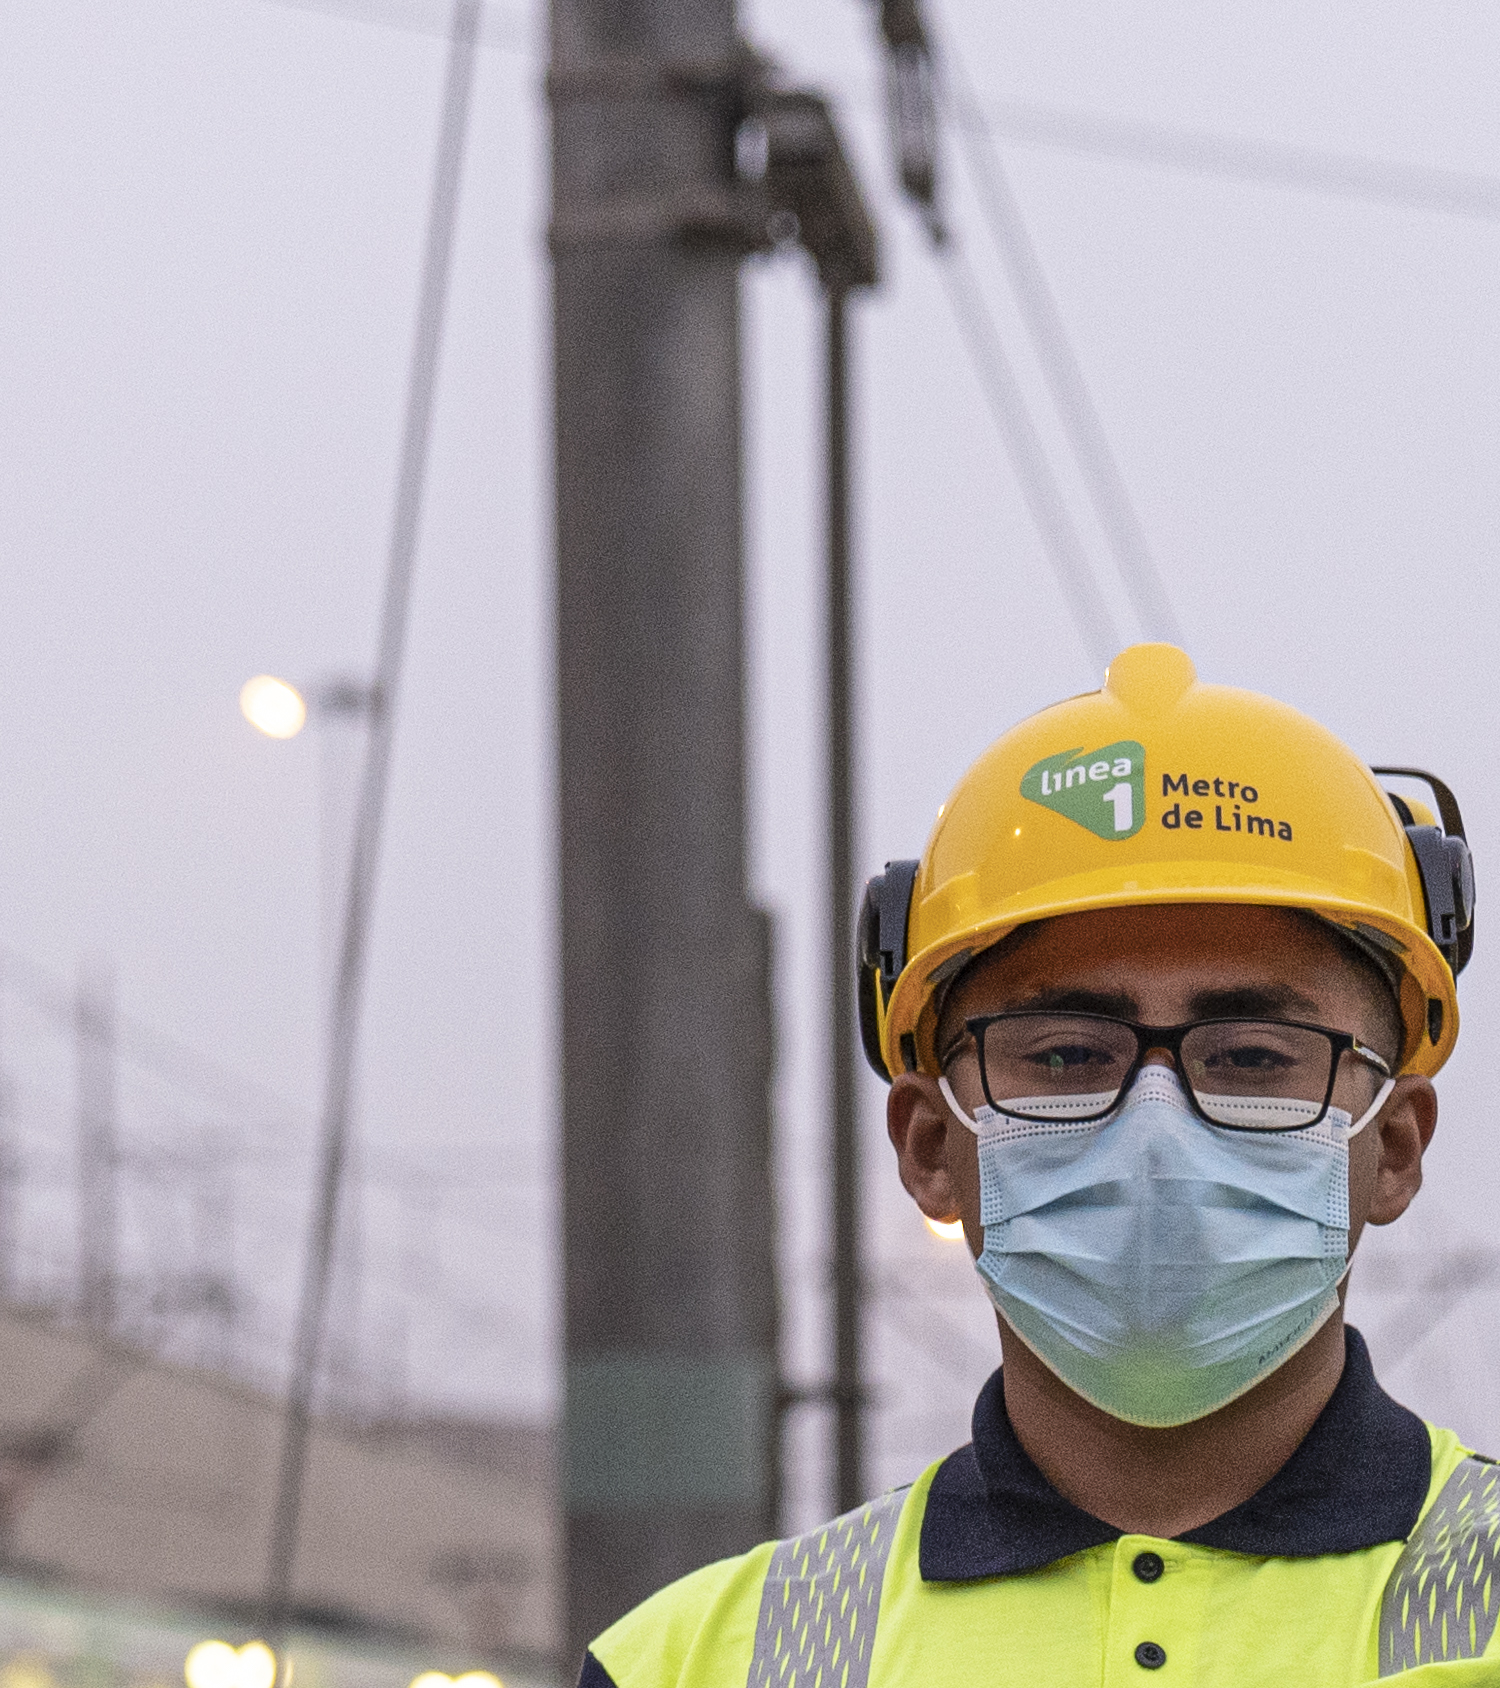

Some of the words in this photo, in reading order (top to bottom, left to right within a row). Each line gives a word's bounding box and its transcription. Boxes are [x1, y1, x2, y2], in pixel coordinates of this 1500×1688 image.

[1103, 782, 1133, 832] 1
[1162, 773, 1259, 803] Metro
[1161, 803, 1203, 829] de
[1215, 804, 1293, 842] Lima
